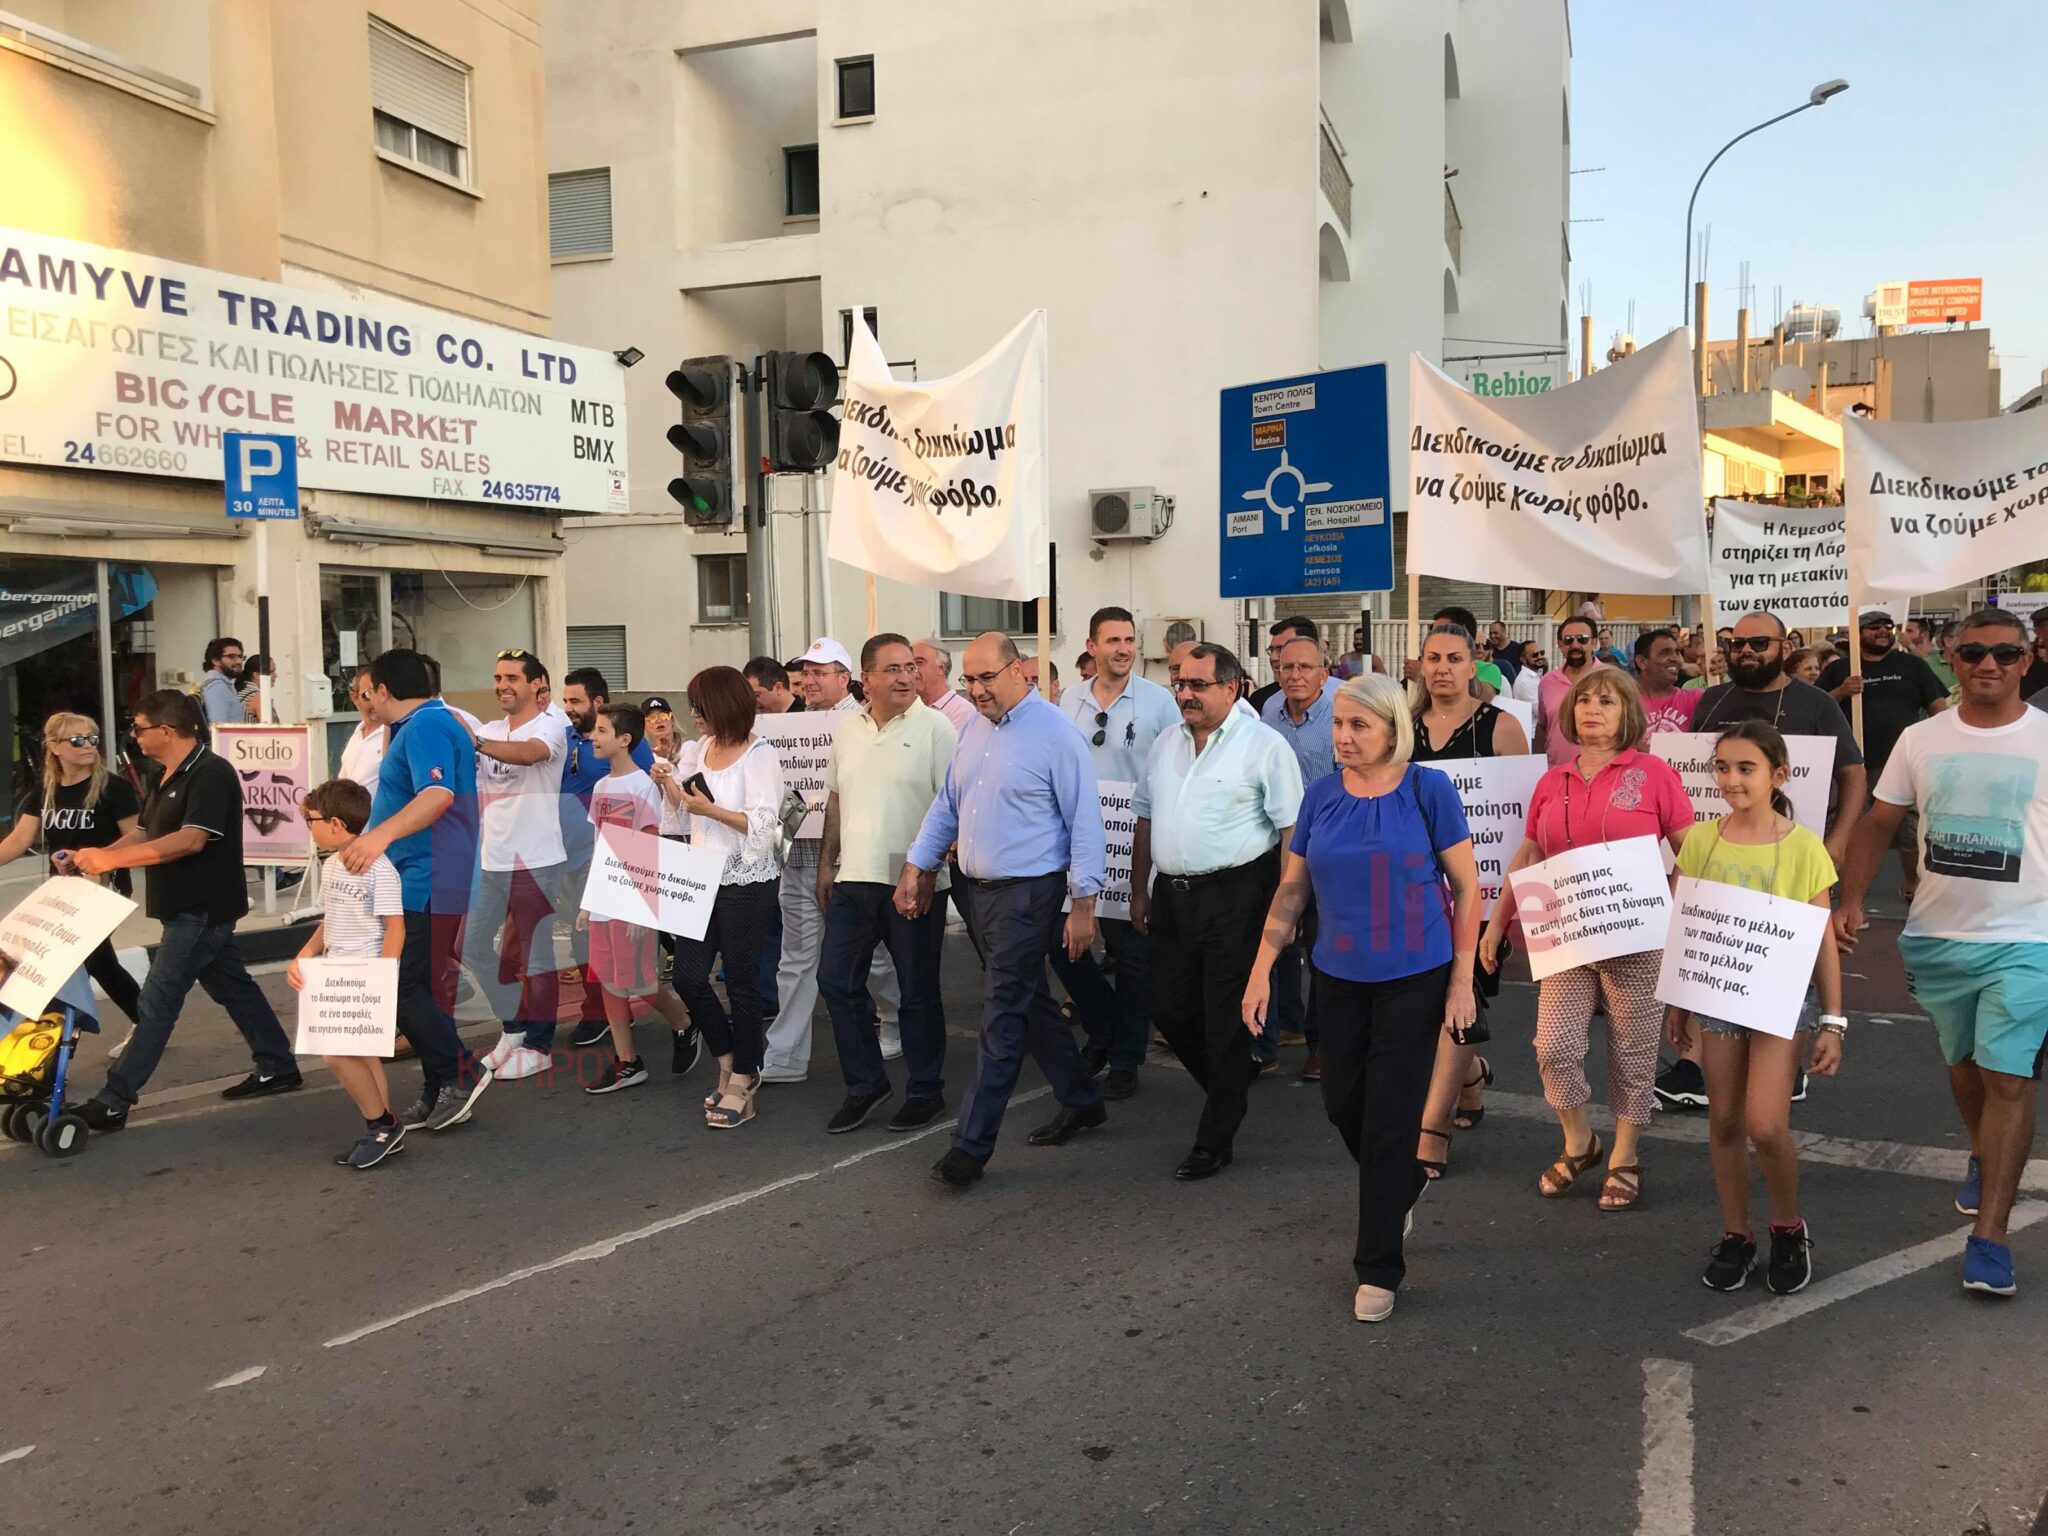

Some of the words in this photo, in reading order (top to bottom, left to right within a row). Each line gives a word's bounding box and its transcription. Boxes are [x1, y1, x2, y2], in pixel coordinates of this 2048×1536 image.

[218, 289, 411, 356] TRADING
[436, 333, 493, 371] CO.
[521, 349, 577, 385] LTD
[8, 306, 199, 365] ΕΙΣΑΓΩΓΕΣ
[209, 340, 258, 374] ΚΑΙ
[267, 350, 399, 395] ΠΩΛΗΣΕΙΣ
[408, 374, 542, 416] ΠΟΔΗΛΑΤΩΝ
[1254, 392, 1284, 403] ΚΕΝΤΡΟ
[1287, 386, 1313, 398] ΠΟΛΗΣ
[115, 371, 295, 424] BICYCLE
[334, 400, 477, 445] MARKET
[571, 399, 614, 428] MTB
[1255, 405, 1272, 413] Town
[1275, 401, 1300, 410] Centre
[1255, 423, 1283, 435] ΜΑΡΙΝΑ
[1255, 436, 1280, 445] Marina
[96, 411, 161, 444] FOR
[326, 438, 409, 469] RETAIL
[420, 447, 490, 476] SALES
[573, 435, 614, 464] BMX
[1411, 425, 1548, 473] Διεκδικούμε
[1551, 456, 1574, 473] το
[1574, 431, 1667, 470] δικαίωμα
[240, 440, 282, 492] P
[852, 445, 908, 493] ζούμε
[482, 480, 560, 503] 24635774
[1869, 471, 2019, 501] Διεκδικούμε
[233, 501, 253, 512] 30
[258, 497, 285, 506] ΛΕΠΤΑ
[1306, 508, 1323, 516] ΓΕΝ.
[1326, 501, 1383, 514] ΝΟΣΟΚΟΜΕΙΟ
[1415, 476, 1445, 498] να
[1449, 473, 1506, 509] ζούμε
[1510, 485, 1582, 521] χωρίς
[1586, 482, 1648, 523] φόβο.
[258, 508, 296, 516] MINUTES
[1233, 513, 1259, 523] ΛΙΜΑΝΙ
[1306, 518, 1323, 526] Gen.
[1327, 515, 1360, 525] Hospital
[1890, 516, 1920, 534] να
[1925, 512, 1997, 538] ζούμε
[2003, 486, 2048, 523] χωρ
[1232, 526, 1247, 534] Port
[1763, 522, 1774, 535] Η
[1778, 520, 1845, 538] Λεμεσός
[1304, 544, 1337, 553] Lefkosia
[1722, 544, 1788, 564] στηρίζει
[1792, 546, 1810, 561] τη
[1815, 541, 1845, 557] Λάρ
[1304, 567, 1340, 575] Lemesos
[1730, 573, 1754, 589] για
[1758, 573, 1776, 587] τη
[1718, 599, 1749, 611] των
[236, 739, 293, 760] Studio
[799, 738, 810, 747] το
[604, 856, 655, 878] Διεκδικούμε
[657, 872, 666, 881] το
[667, 872, 707, 891] δικαίωμα
[1553, 870, 1591, 890] Δύναμη
[1592, 867, 1613, 881] μας
[607, 873, 617, 883] να
[619, 874, 644, 891] ζούμε
[643, 882, 670, 898] χωρίς
[670, 886, 696, 904] φόβο.
[1546, 898, 1566, 912] είναι
[1568, 895, 1573, 904] ο
[1575, 885, 1607, 902] τόπος
[1609, 881, 1633, 896] μας,
[1530, 926, 1539, 936] κι
[1540, 918, 1560, 935] αυτή
[1561, 912, 1578, 927] μας
[1579, 904, 1605, 919] δίνει
[1606, 902, 1621, 914] τη
[1622, 895, 1664, 910] δύναμη
[1681, 902, 1731, 925] Διεκδικούμε
[1733, 916, 1747, 928] το
[1748, 919, 1795, 940] μέλλον
[1551, 938, 1562, 947] να
[1563, 917, 1644, 943] διεκδικήσουμε.
[1684, 926, 1699, 939] των
[1700, 930, 1743, 949] παιδιών
[1745, 941, 1769, 957] μας
[1684, 948, 1697, 960] και
[1699, 951, 1709, 961] το
[1710, 954, 1753, 973] μέλλον
[325, 977, 367, 989] Διεκδικούμε
[1678, 967, 1691, 982] της
[1692, 969, 1722, 989] πόλης
[1723, 981, 1750, 996] μας.
[311, 994, 318, 1003] το
[319, 993, 351, 1006] δικαίωμα
[352, 995, 361, 1003] να
[361, 993, 381, 1005] ζούμε
[319, 1010, 327, 1018] σε
[328, 1009, 340, 1018] ένα
[342, 1009, 371, 1019] ασφαλές
[317, 1024, 342, 1035] υγιεινό
[343, 1024, 384, 1036] περιβάλλον.
